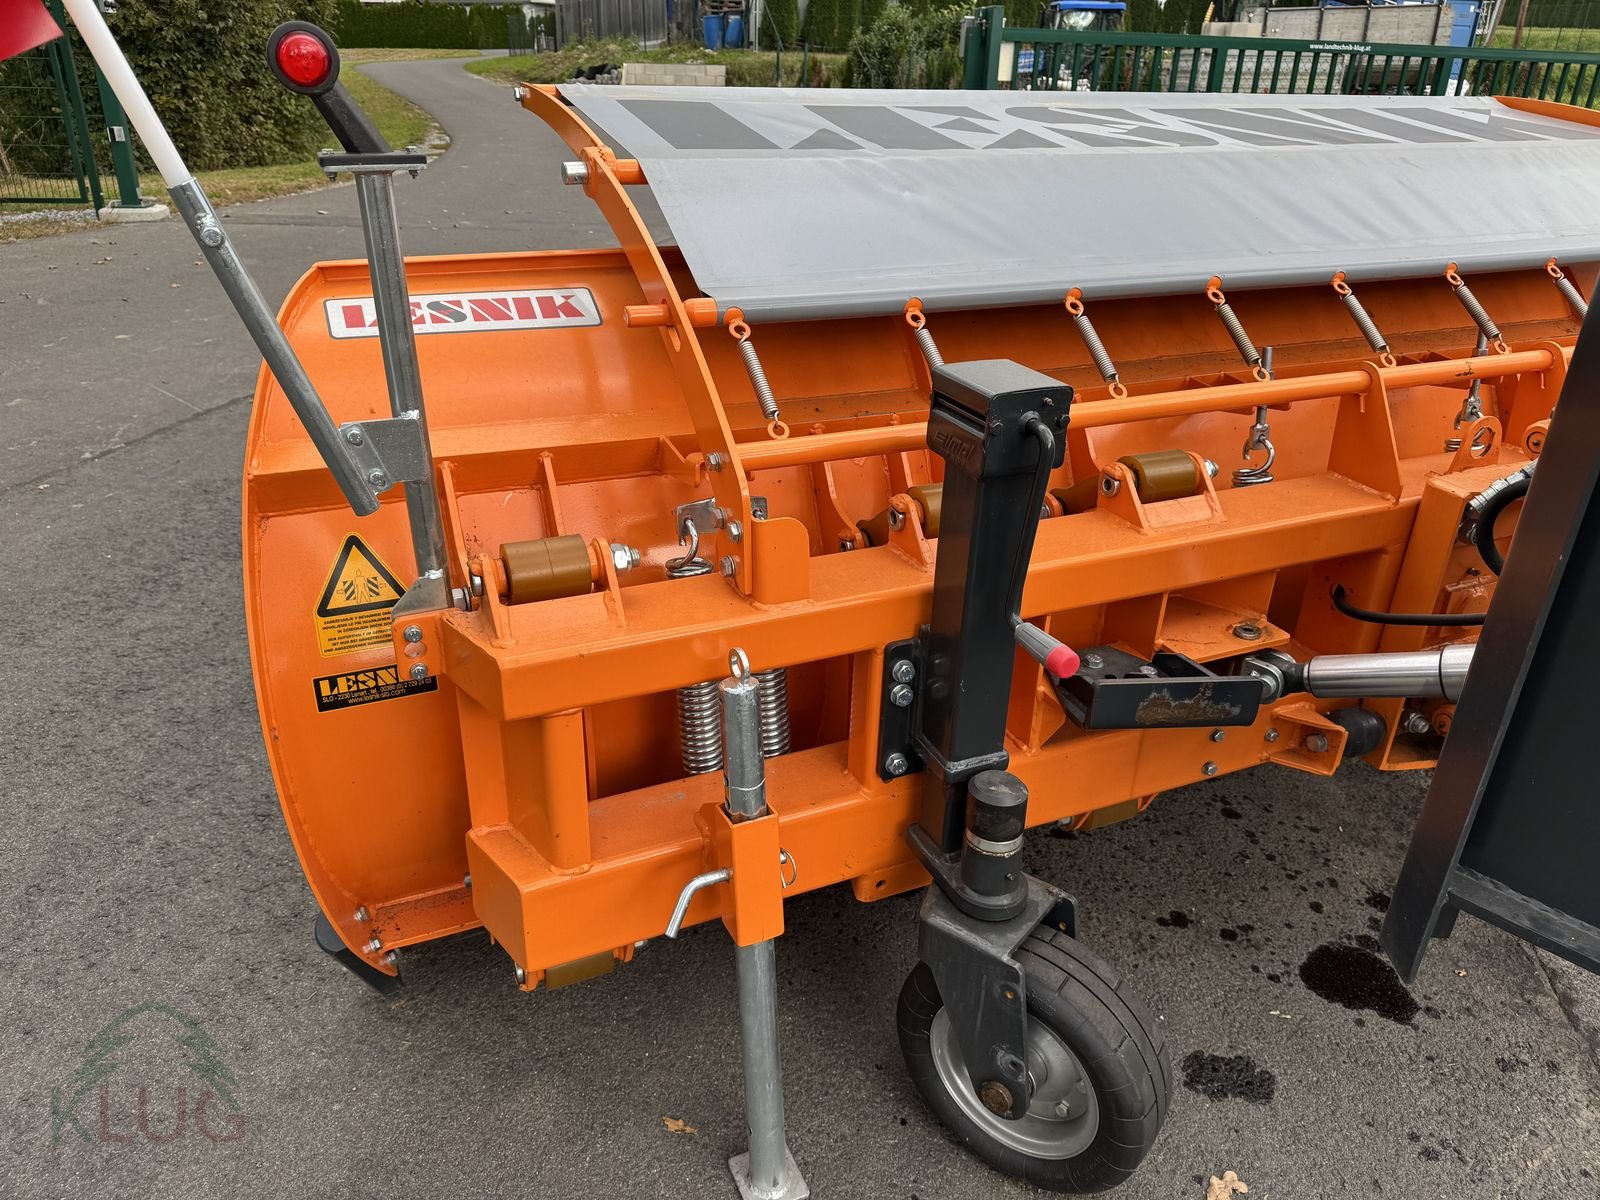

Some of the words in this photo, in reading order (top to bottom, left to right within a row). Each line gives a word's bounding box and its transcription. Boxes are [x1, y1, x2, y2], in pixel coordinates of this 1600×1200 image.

[1309, 43, 1371, 52] www.landtechnik-klug.at
[338, 693, 350, 701] 2230
[348, 690, 406, 704] www.lesnik-slo.com
